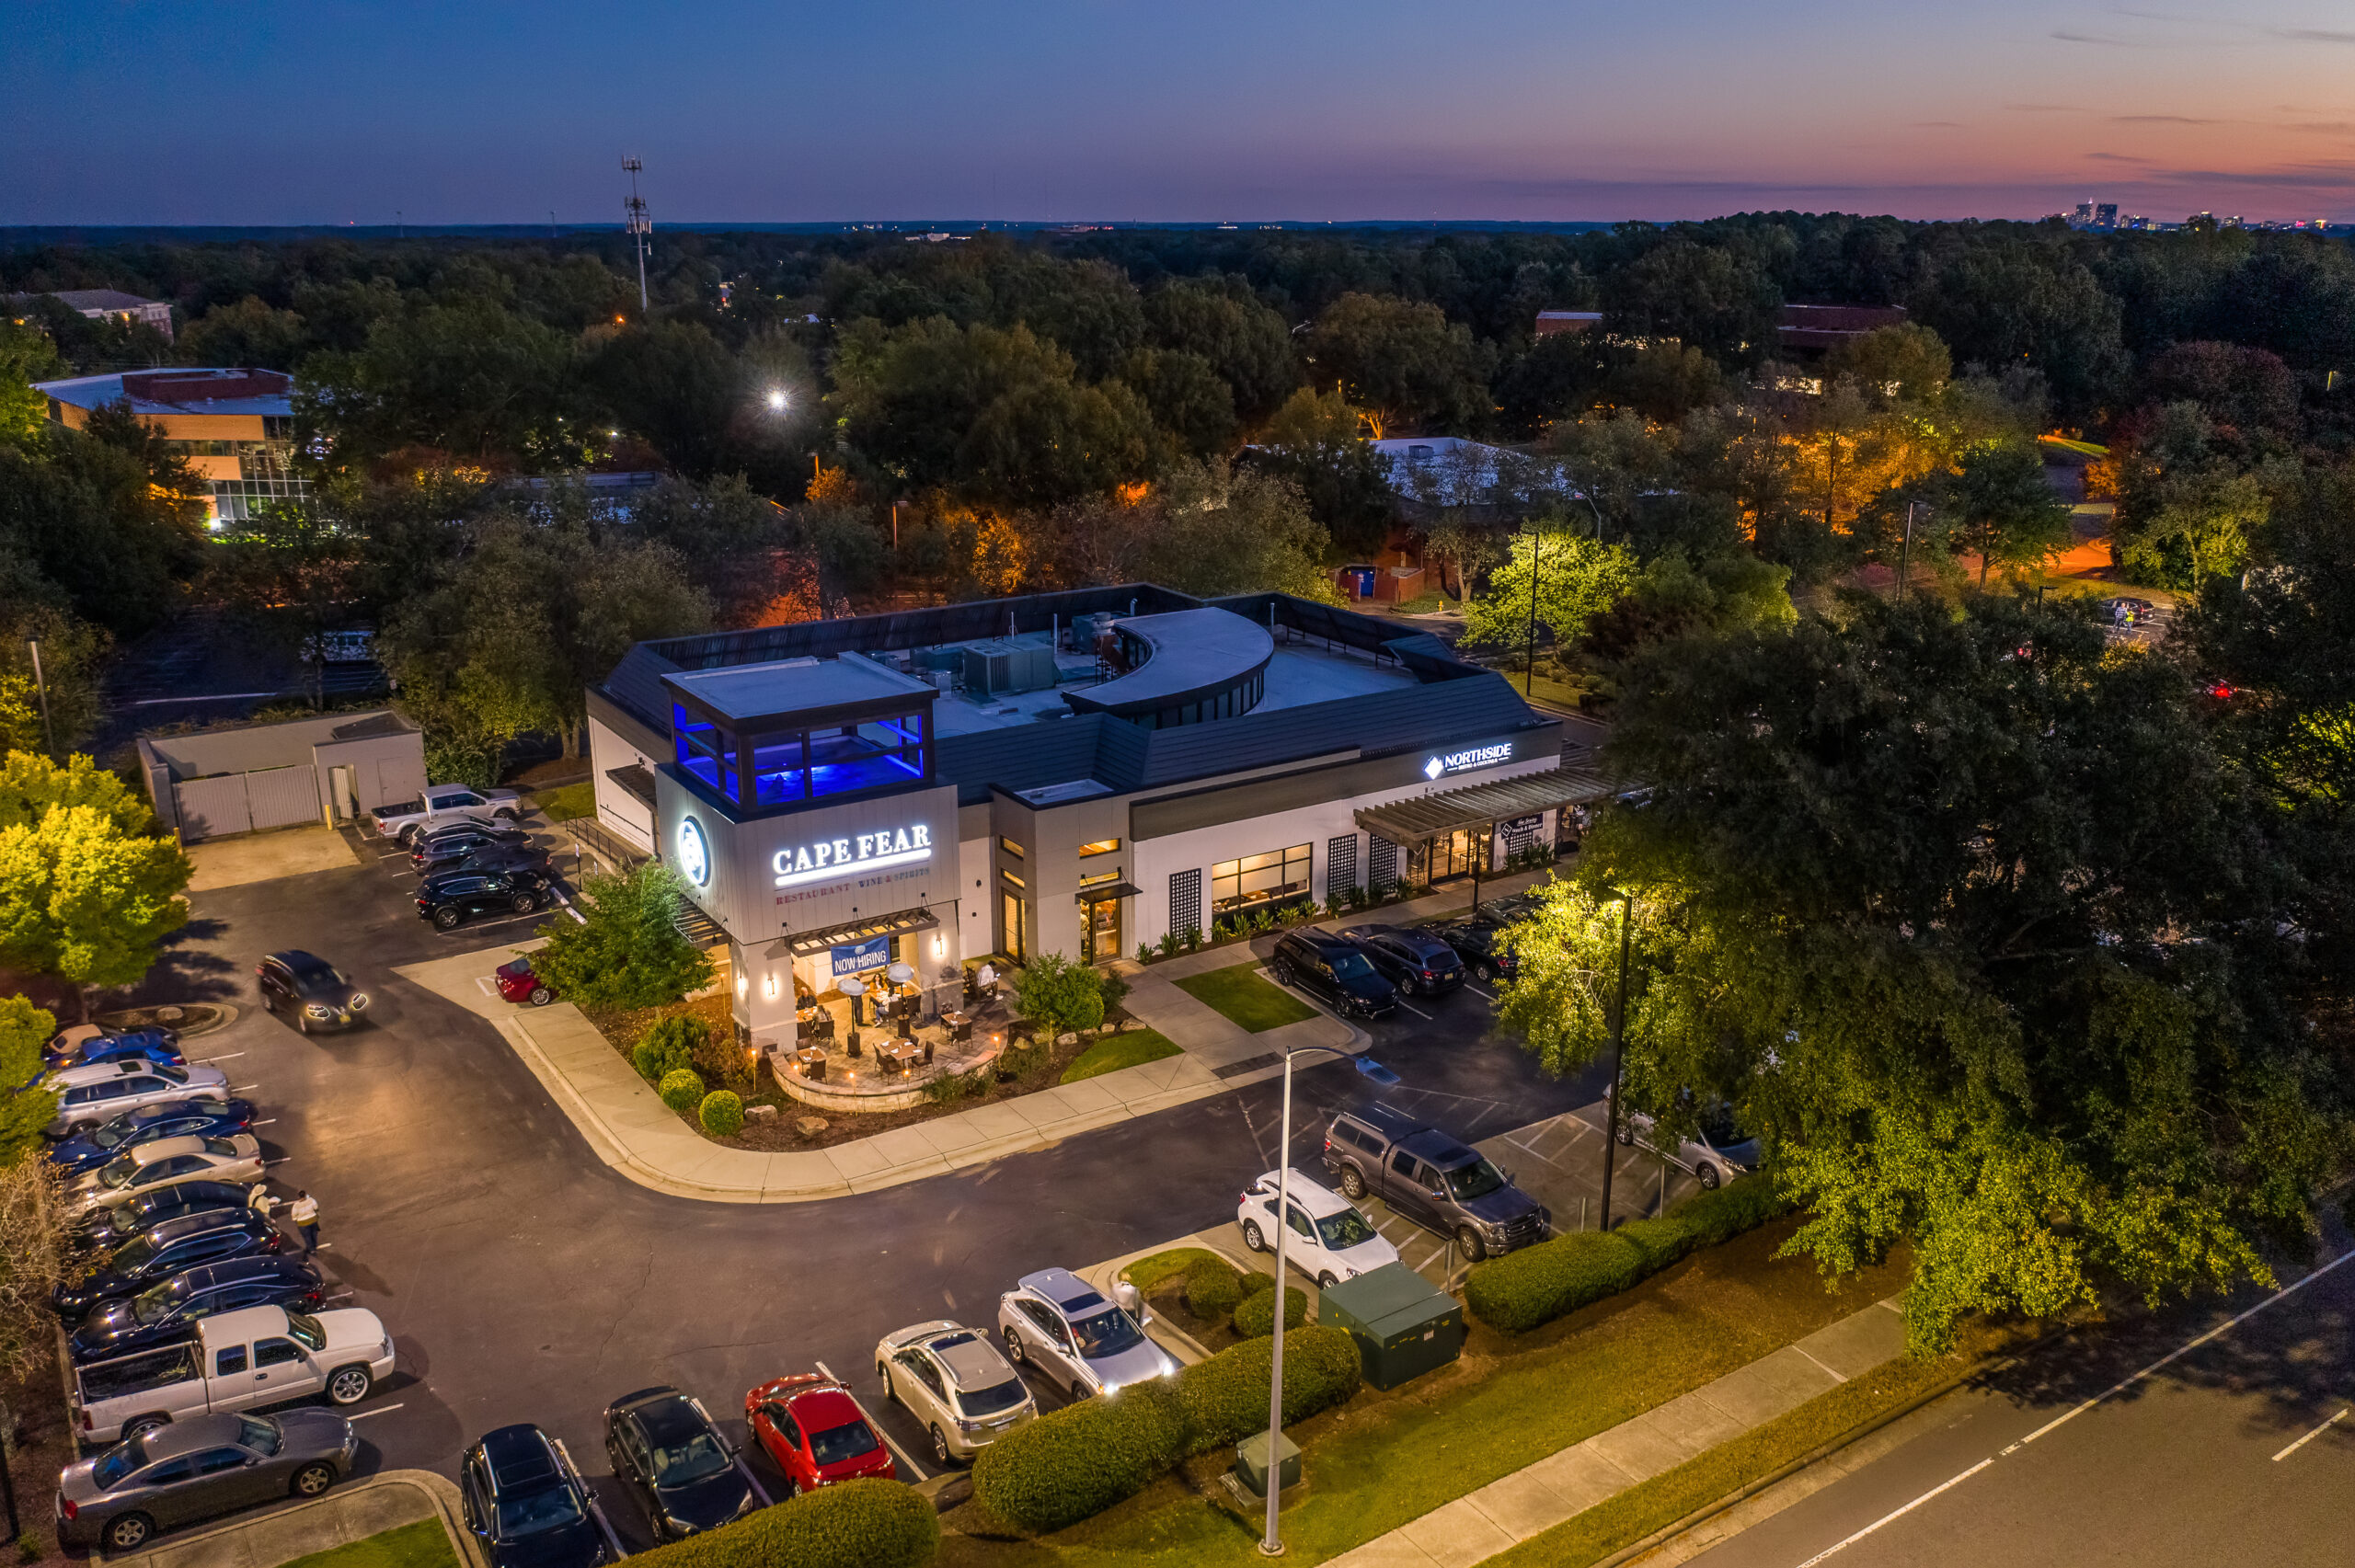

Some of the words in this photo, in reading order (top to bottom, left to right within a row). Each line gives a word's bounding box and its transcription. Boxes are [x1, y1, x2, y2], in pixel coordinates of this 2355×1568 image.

[1444, 743, 1511, 767] NORTHSIDE
[773, 839, 851, 875] CAPE
[857, 825, 932, 859] FEAR
[857, 876, 883, 888] WINE
[886, 875, 891, 883] &
[894, 866, 930, 881] SPIRITS
[775, 882, 851, 906] RESTAURANT
[834, 956, 856, 973] NOW
[857, 950, 887, 968] HIRING
